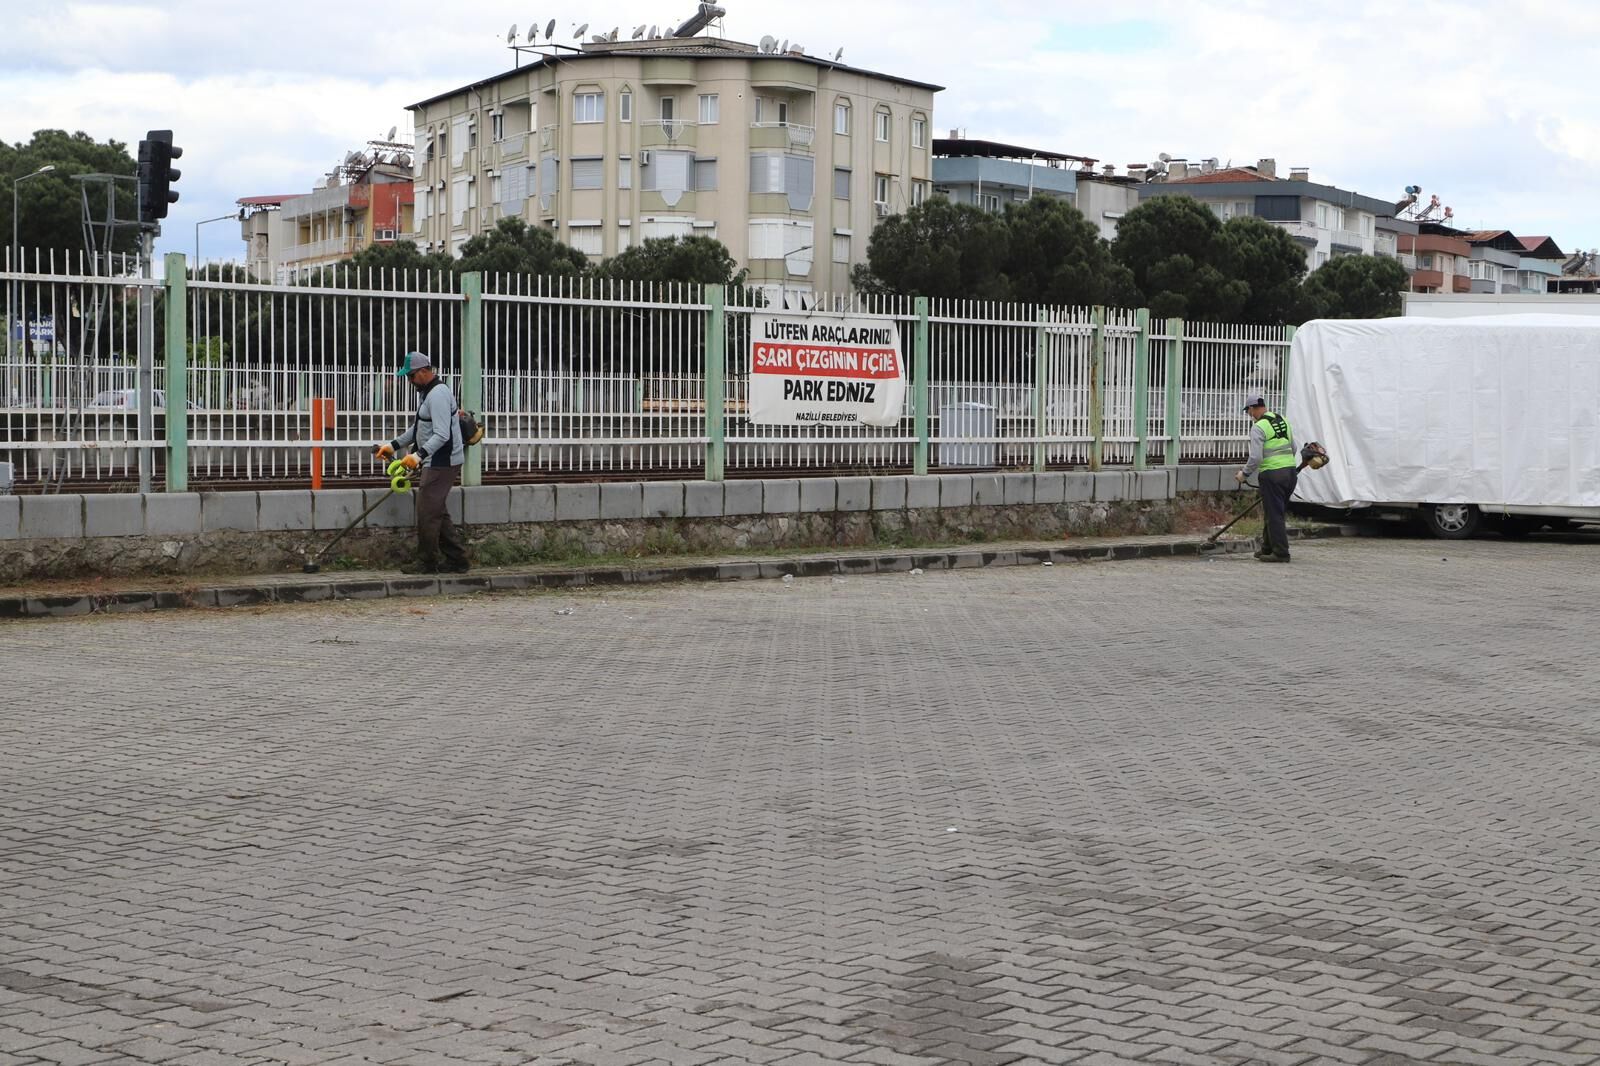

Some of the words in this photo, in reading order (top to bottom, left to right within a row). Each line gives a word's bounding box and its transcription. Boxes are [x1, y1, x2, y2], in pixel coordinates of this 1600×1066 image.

[765, 319, 808, 341] LÜTFEN
[757, 347, 792, 368] SARI
[784, 379, 824, 401] PARK
[795, 410, 821, 422] NAZİLLİ
[821, 410, 858, 422] BELEDİYESİ
